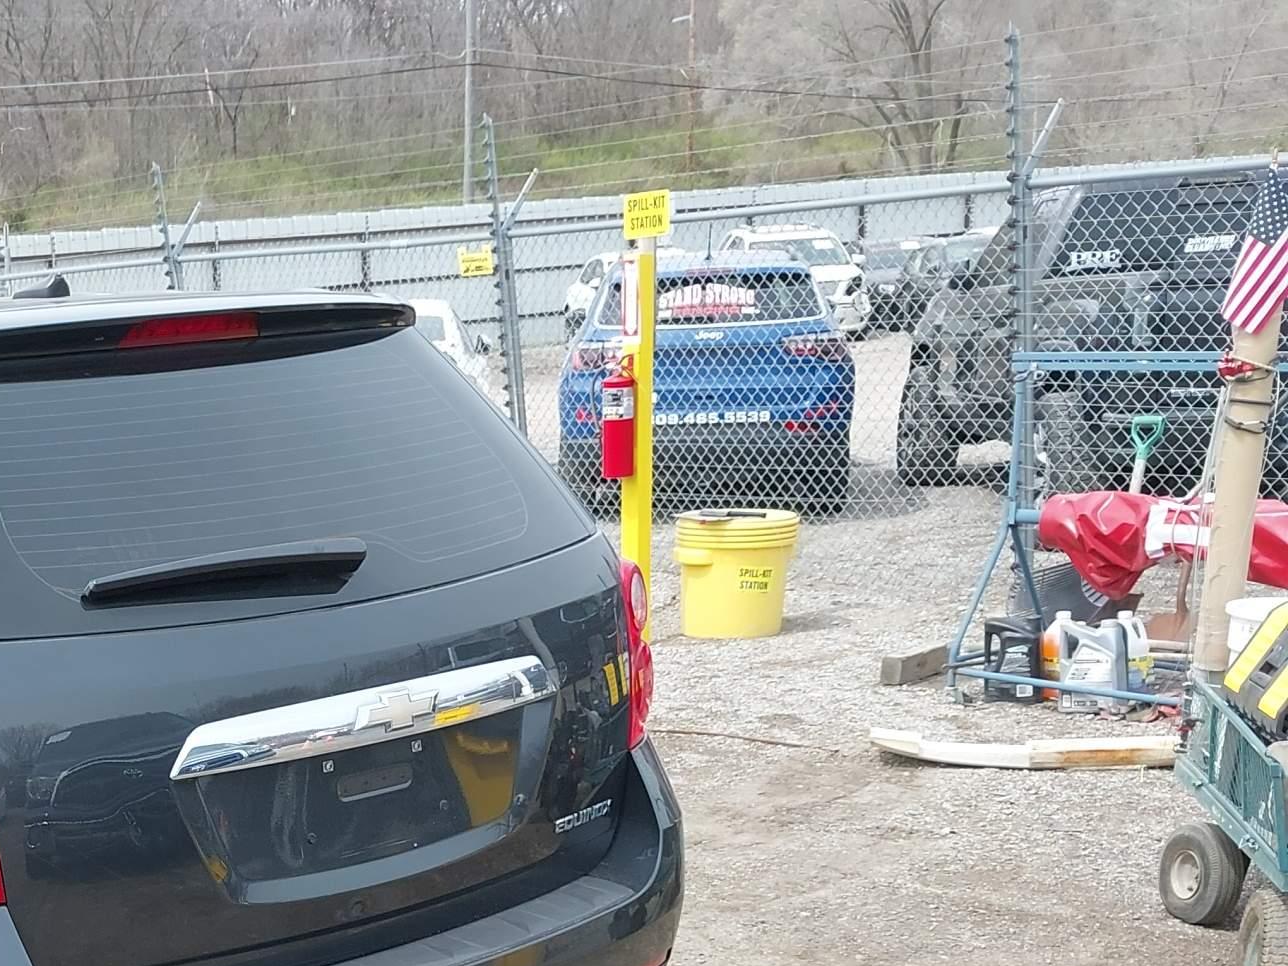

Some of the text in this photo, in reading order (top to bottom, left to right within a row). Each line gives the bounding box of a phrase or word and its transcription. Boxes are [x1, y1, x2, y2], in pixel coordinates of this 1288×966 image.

[628, 195, 665, 213] SPILL-KIT
[630, 215, 663, 231] STATION
[658, 282, 755, 309] STAND STRONG
[695, 330, 725, 341] Jeep
[651, 410, 771, 425] 09.485.5539
[739, 568, 773, 578] SPILL-KIT
[739, 580, 768, 590] STATION
